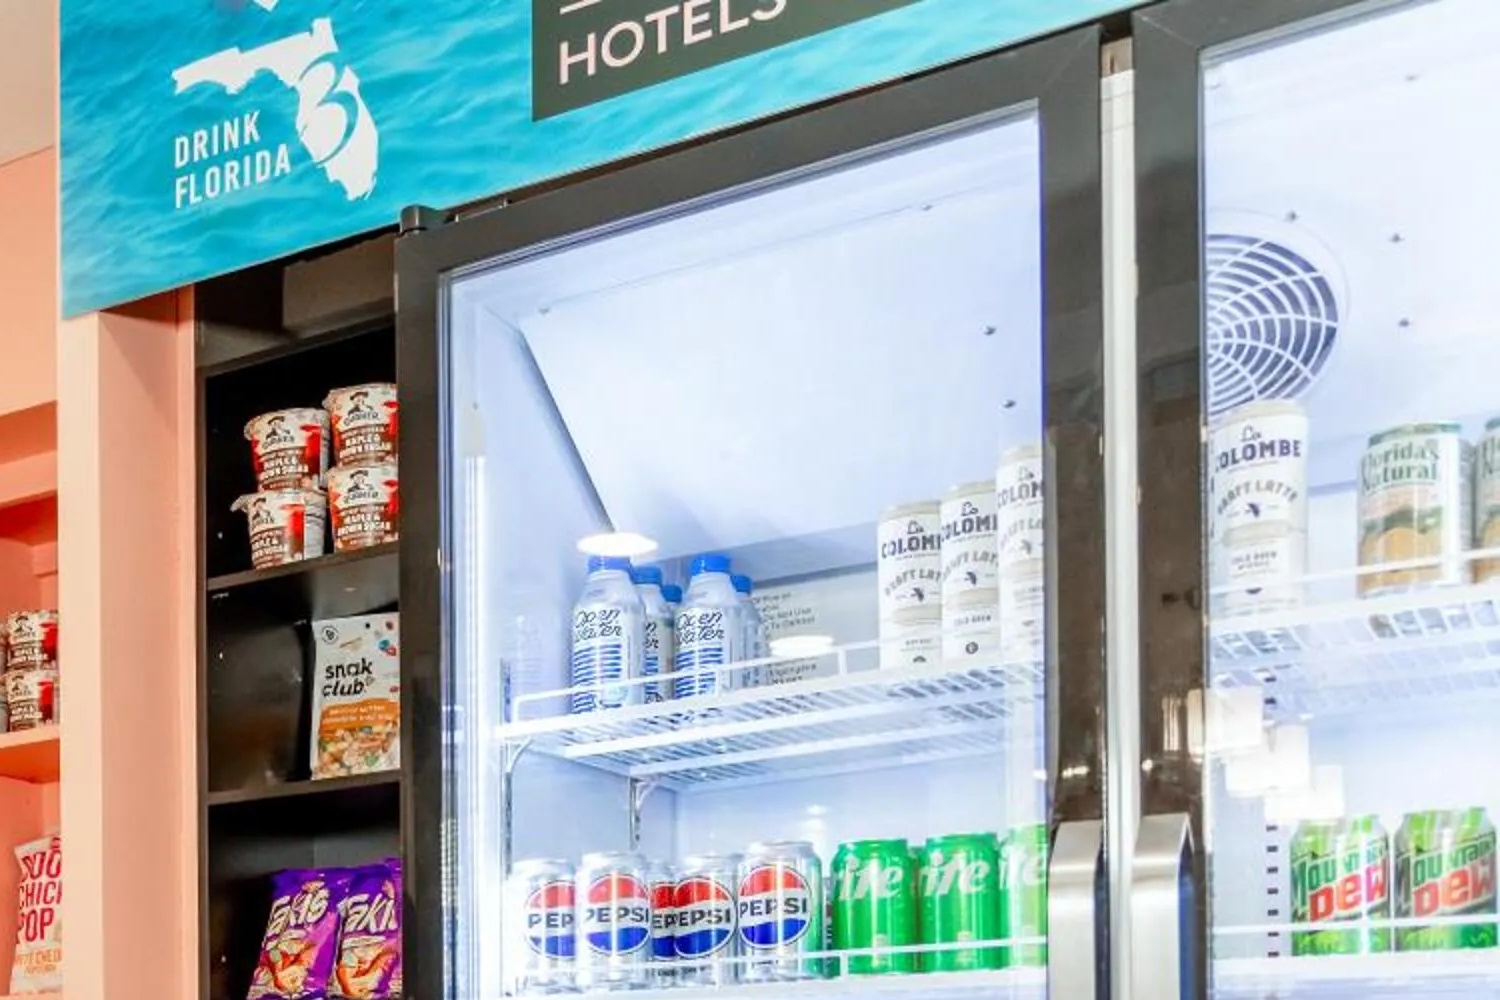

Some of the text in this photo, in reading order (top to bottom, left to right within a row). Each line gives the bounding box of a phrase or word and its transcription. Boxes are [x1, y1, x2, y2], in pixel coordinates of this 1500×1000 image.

[174, 109, 261, 169] DRINK
[175, 143, 291, 209] FLORIDA
[881, 533, 941, 559] COLOM
[325, 657, 373, 680] snak
[322, 678, 365, 697] club
[586, 906, 649, 924] PEPSI
[739, 897, 808, 918] PEPSI
[528, 914, 574, 929] PEP
